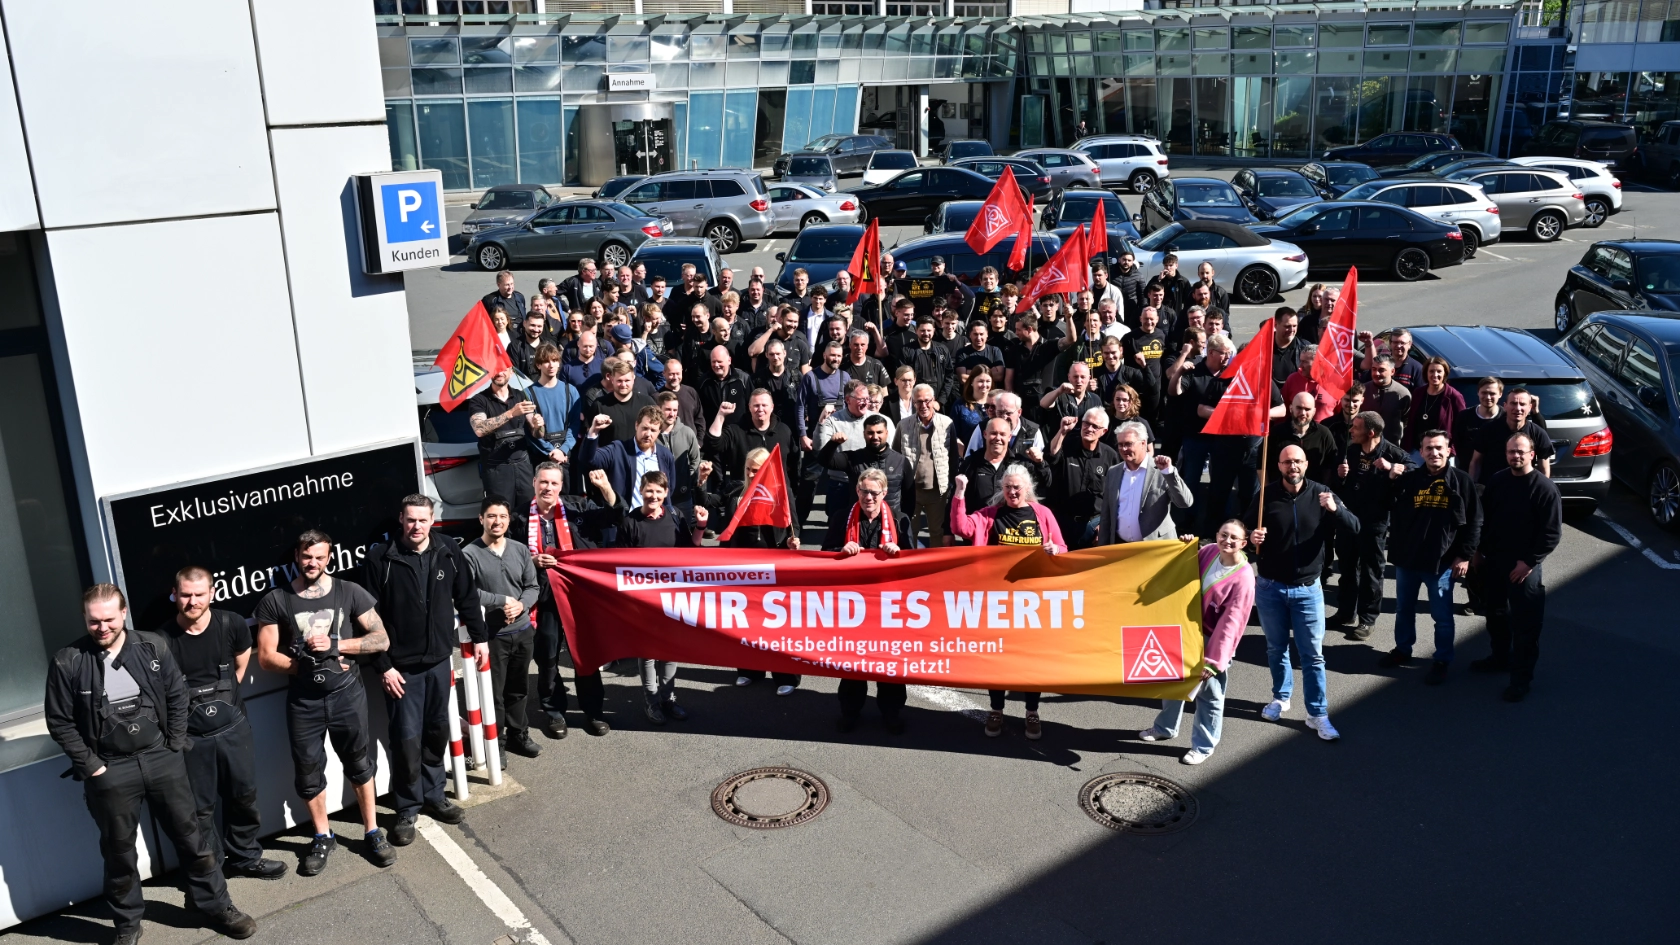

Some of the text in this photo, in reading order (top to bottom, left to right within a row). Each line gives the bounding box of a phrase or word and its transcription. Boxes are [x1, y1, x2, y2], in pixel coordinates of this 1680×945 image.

[611, 79, 645, 87] Annahme
[398, 189, 422, 223] P
[391, 247, 440, 262] Kunden
[150, 471, 354, 528] Exklusivannahme
[998, 533, 1043, 544] TARIFRUNDE
[1005, 527, 1020, 536] KFZ
[622, 570, 770, 585] Rosier Hannover:
[660, 589, 1085, 629] WIR SIND ES WERT!
[740, 636, 1004, 655] Arbeitsbedingungen sichern!
[903, 658, 951, 677] jetzt!
